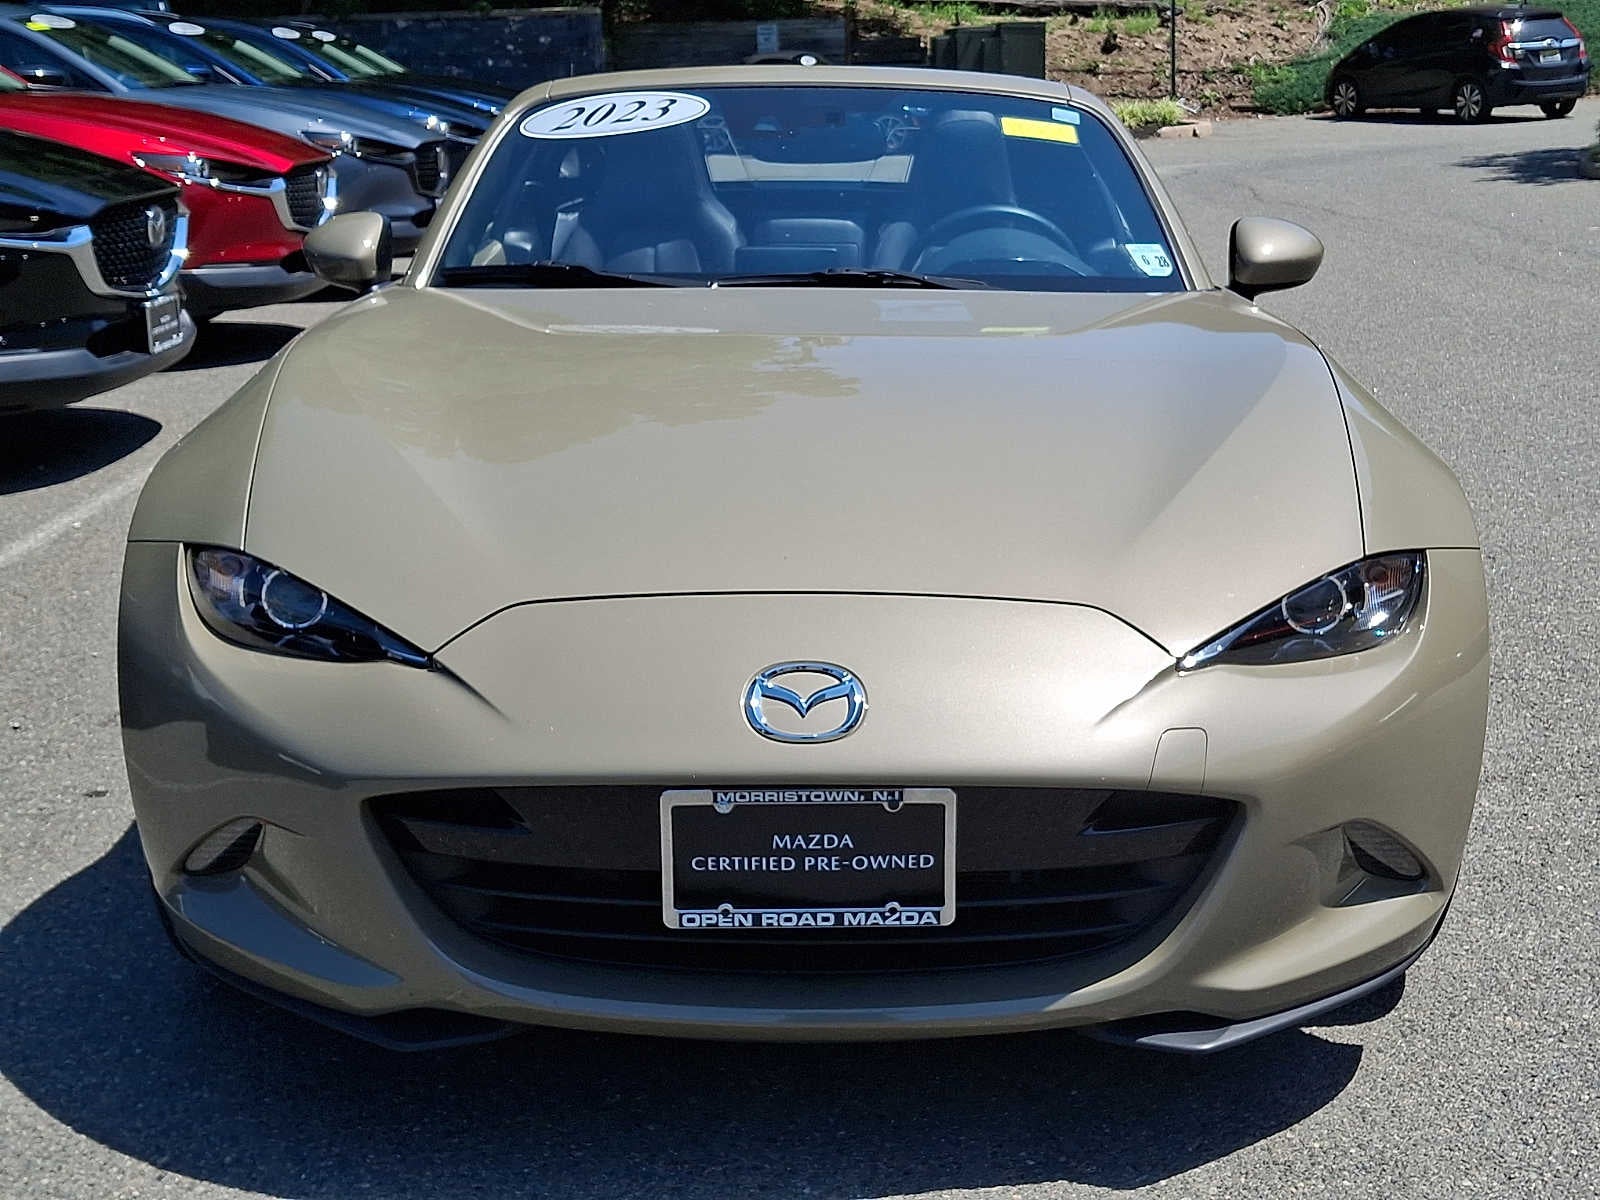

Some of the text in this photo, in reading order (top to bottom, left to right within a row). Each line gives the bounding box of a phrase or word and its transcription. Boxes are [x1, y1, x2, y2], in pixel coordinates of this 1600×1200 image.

[550, 98, 678, 132] 2023
[772, 833, 854, 850] MAZDA
[691, 853, 935, 872] CERTIFIED PRE-OWNED
[681, 910, 939, 928] OPEN ROAD MAZDA
